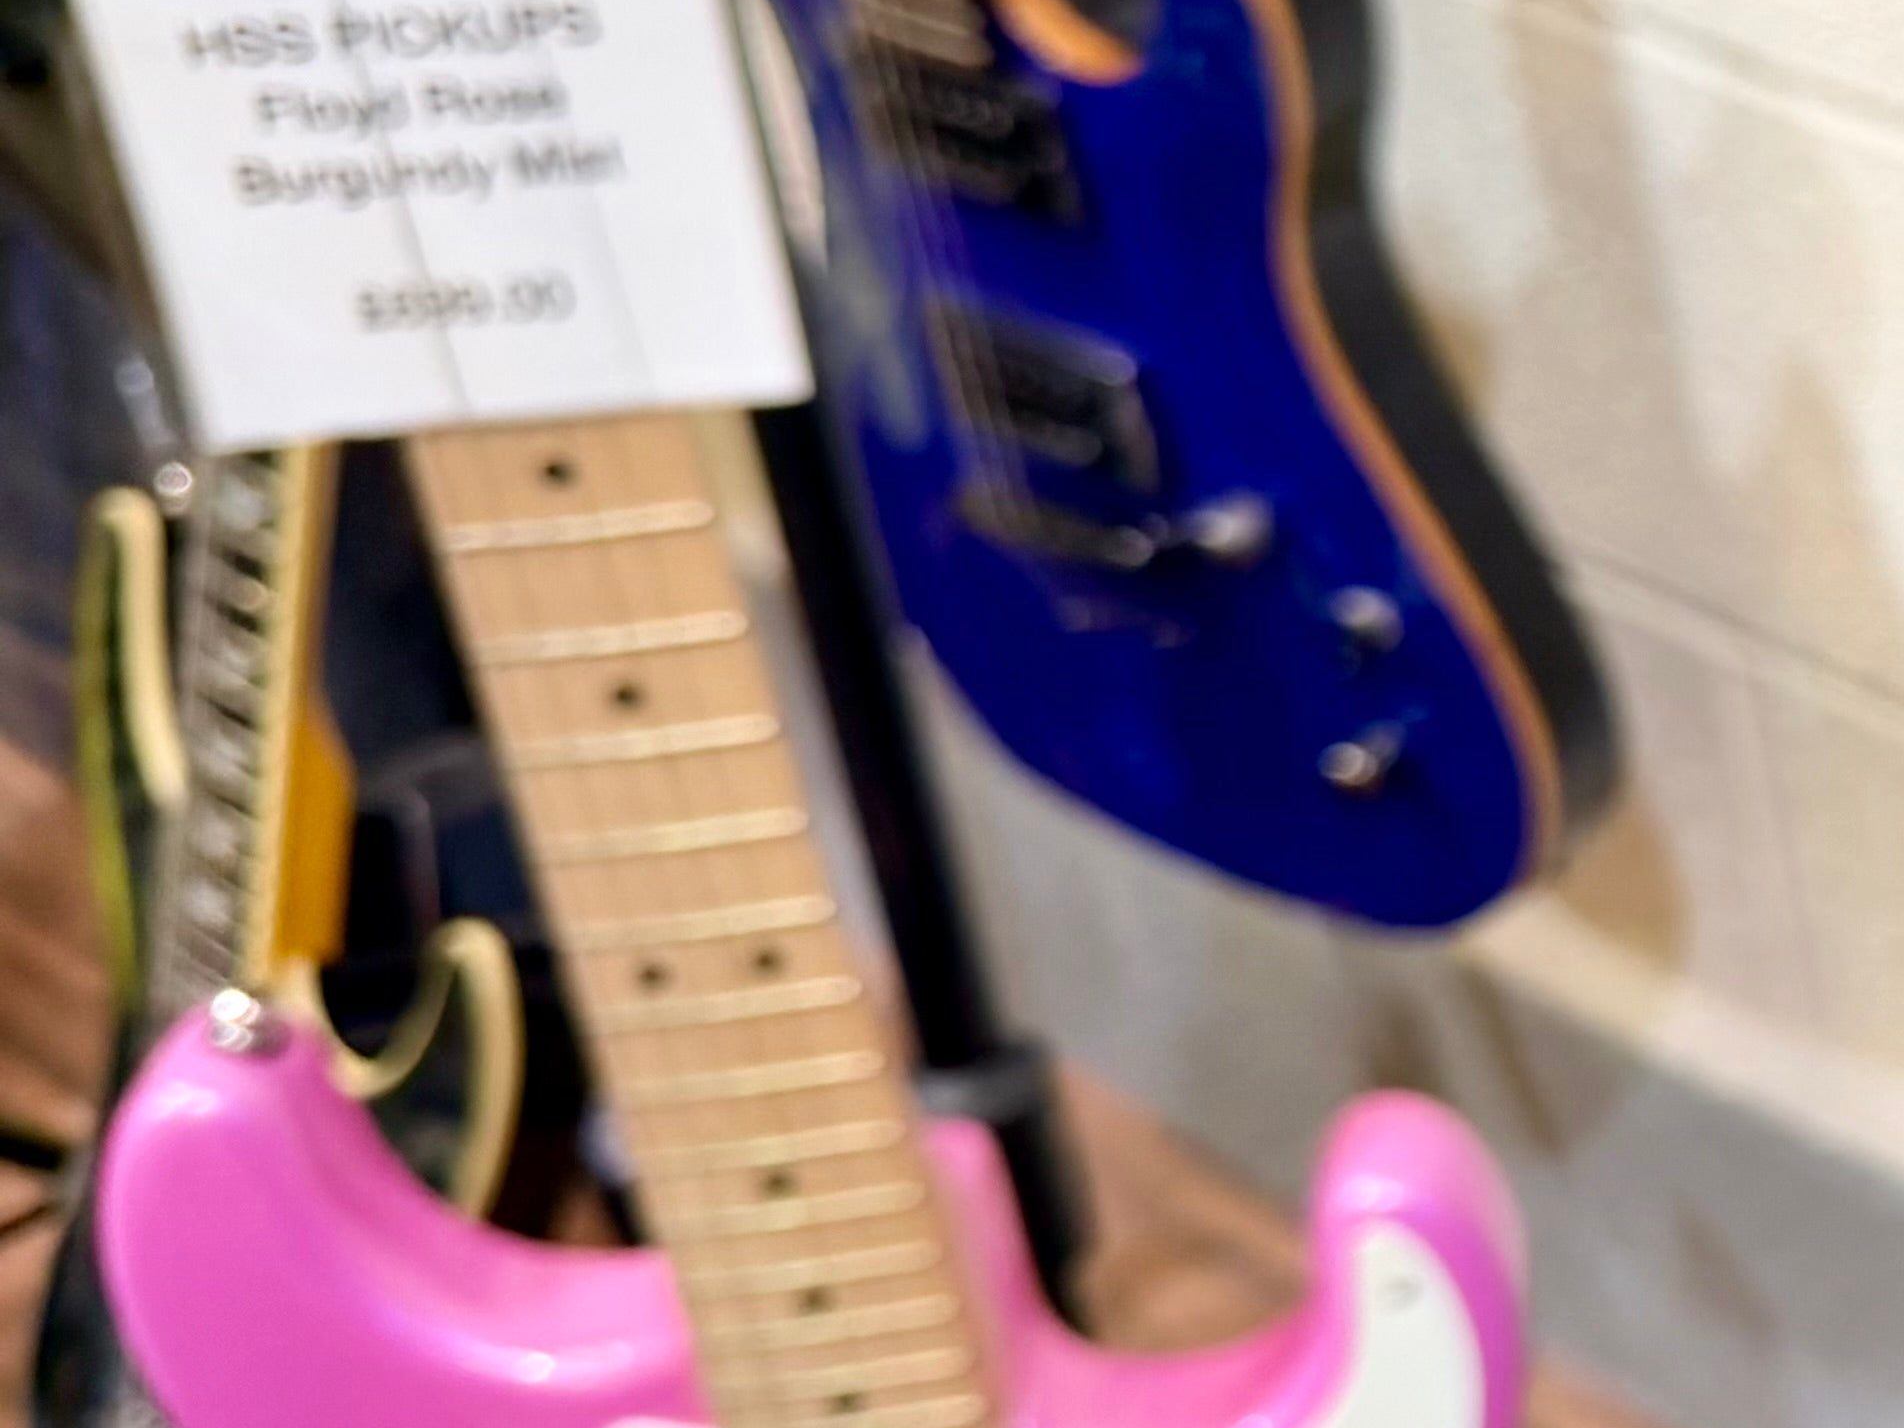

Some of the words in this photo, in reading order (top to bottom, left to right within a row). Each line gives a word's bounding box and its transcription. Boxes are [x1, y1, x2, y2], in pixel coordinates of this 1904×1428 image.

[178, 12, 318, 69] HSS
[253, 81, 411, 139] Floyd
[415, 73, 572, 126] Rose
[231, 149, 496, 212] Burgundy
